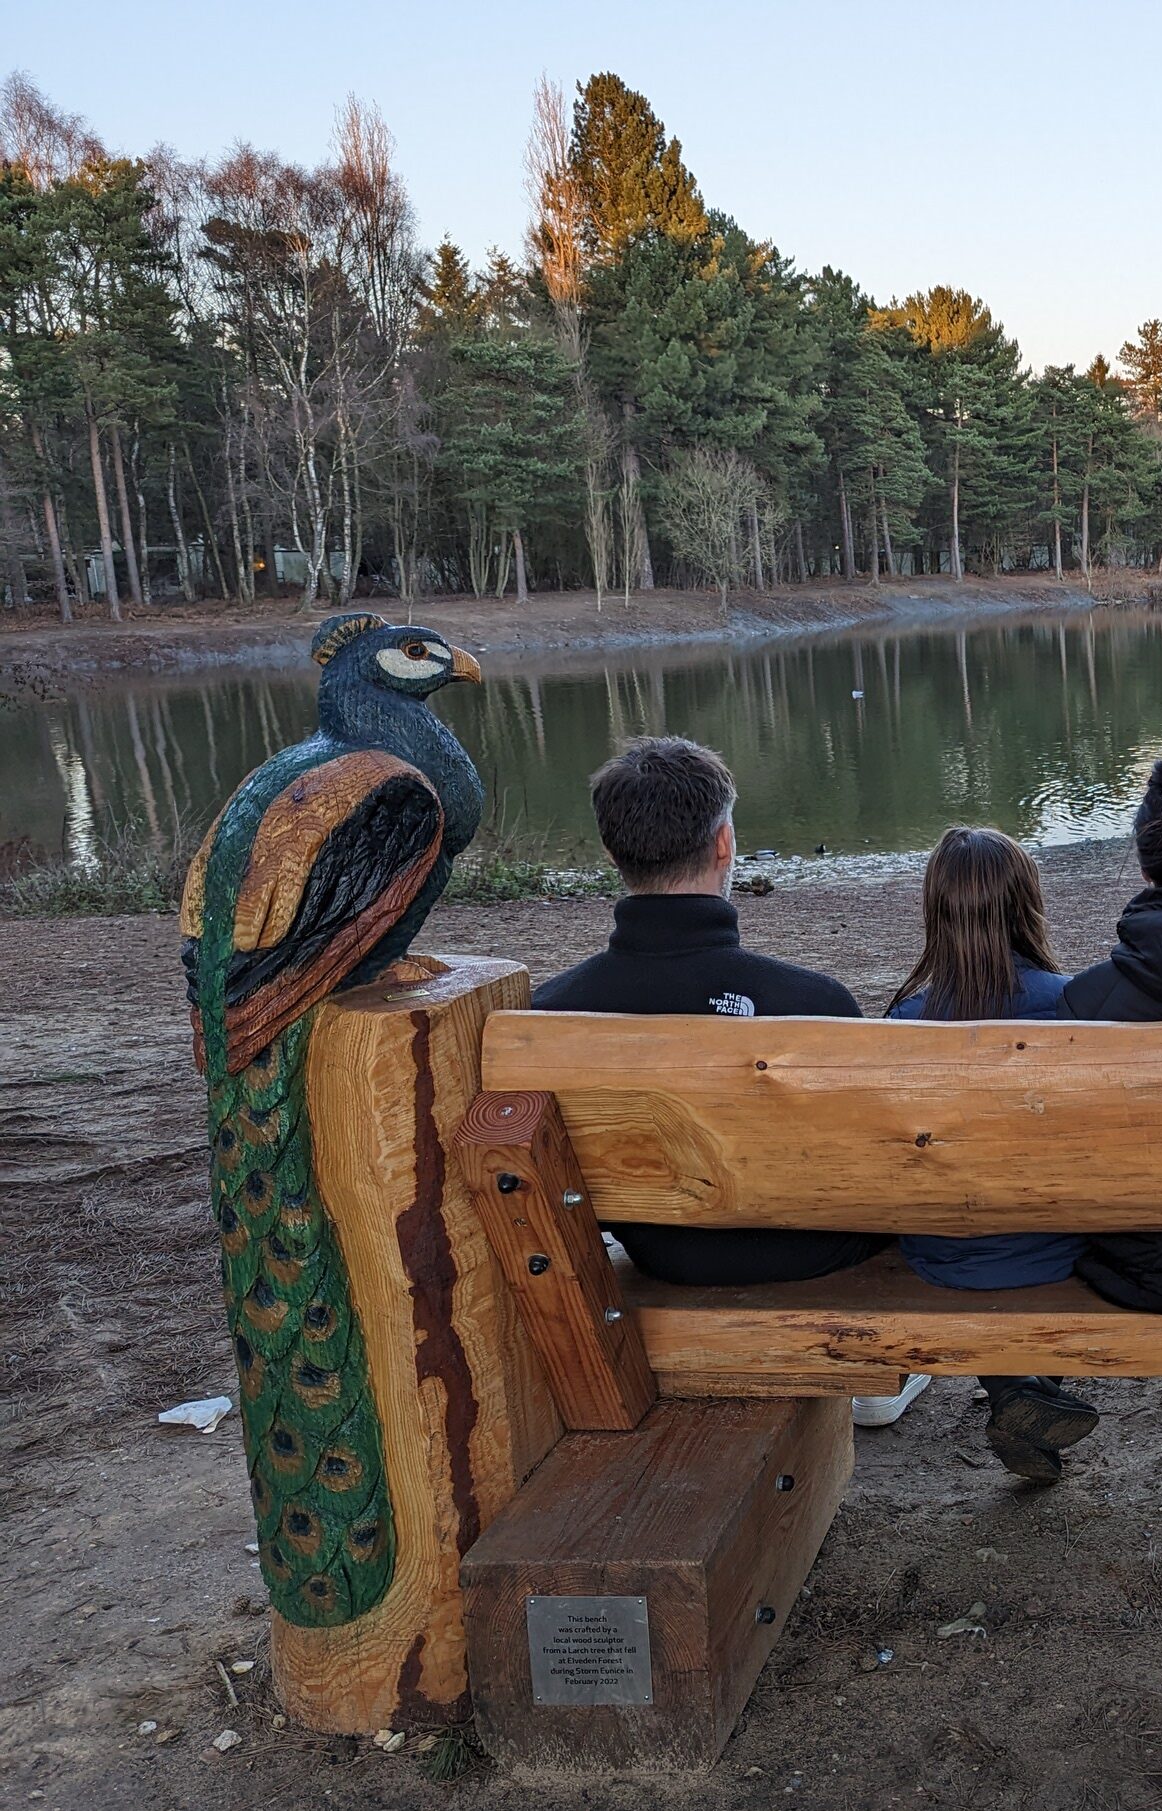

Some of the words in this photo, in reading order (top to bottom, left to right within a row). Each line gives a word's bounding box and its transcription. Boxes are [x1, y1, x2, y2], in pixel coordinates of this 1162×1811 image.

[722, 992, 741, 1001] THE
[708, 997, 740, 1008] NORTH
[716, 1005, 739, 1015] FACE
[574, 1625, 601, 1633] crafted
[602, 1625, 611, 1634] by
[593, 1636, 624, 1645] sculptor
[542, 1646, 561, 1654] from
[568, 1646, 589, 1654] Larch
[607, 1646, 623, 1654] that
[624, 1646, 637, 1654] fell
[550, 1667, 575, 1676] during
[575, 1667, 599, 1675] Storm
[600, 1667, 625, 1675] Eunice
[626, 1666, 634, 1674] in
[564, 1677, 598, 1685] February
[599, 1677, 618, 1685] 2022
